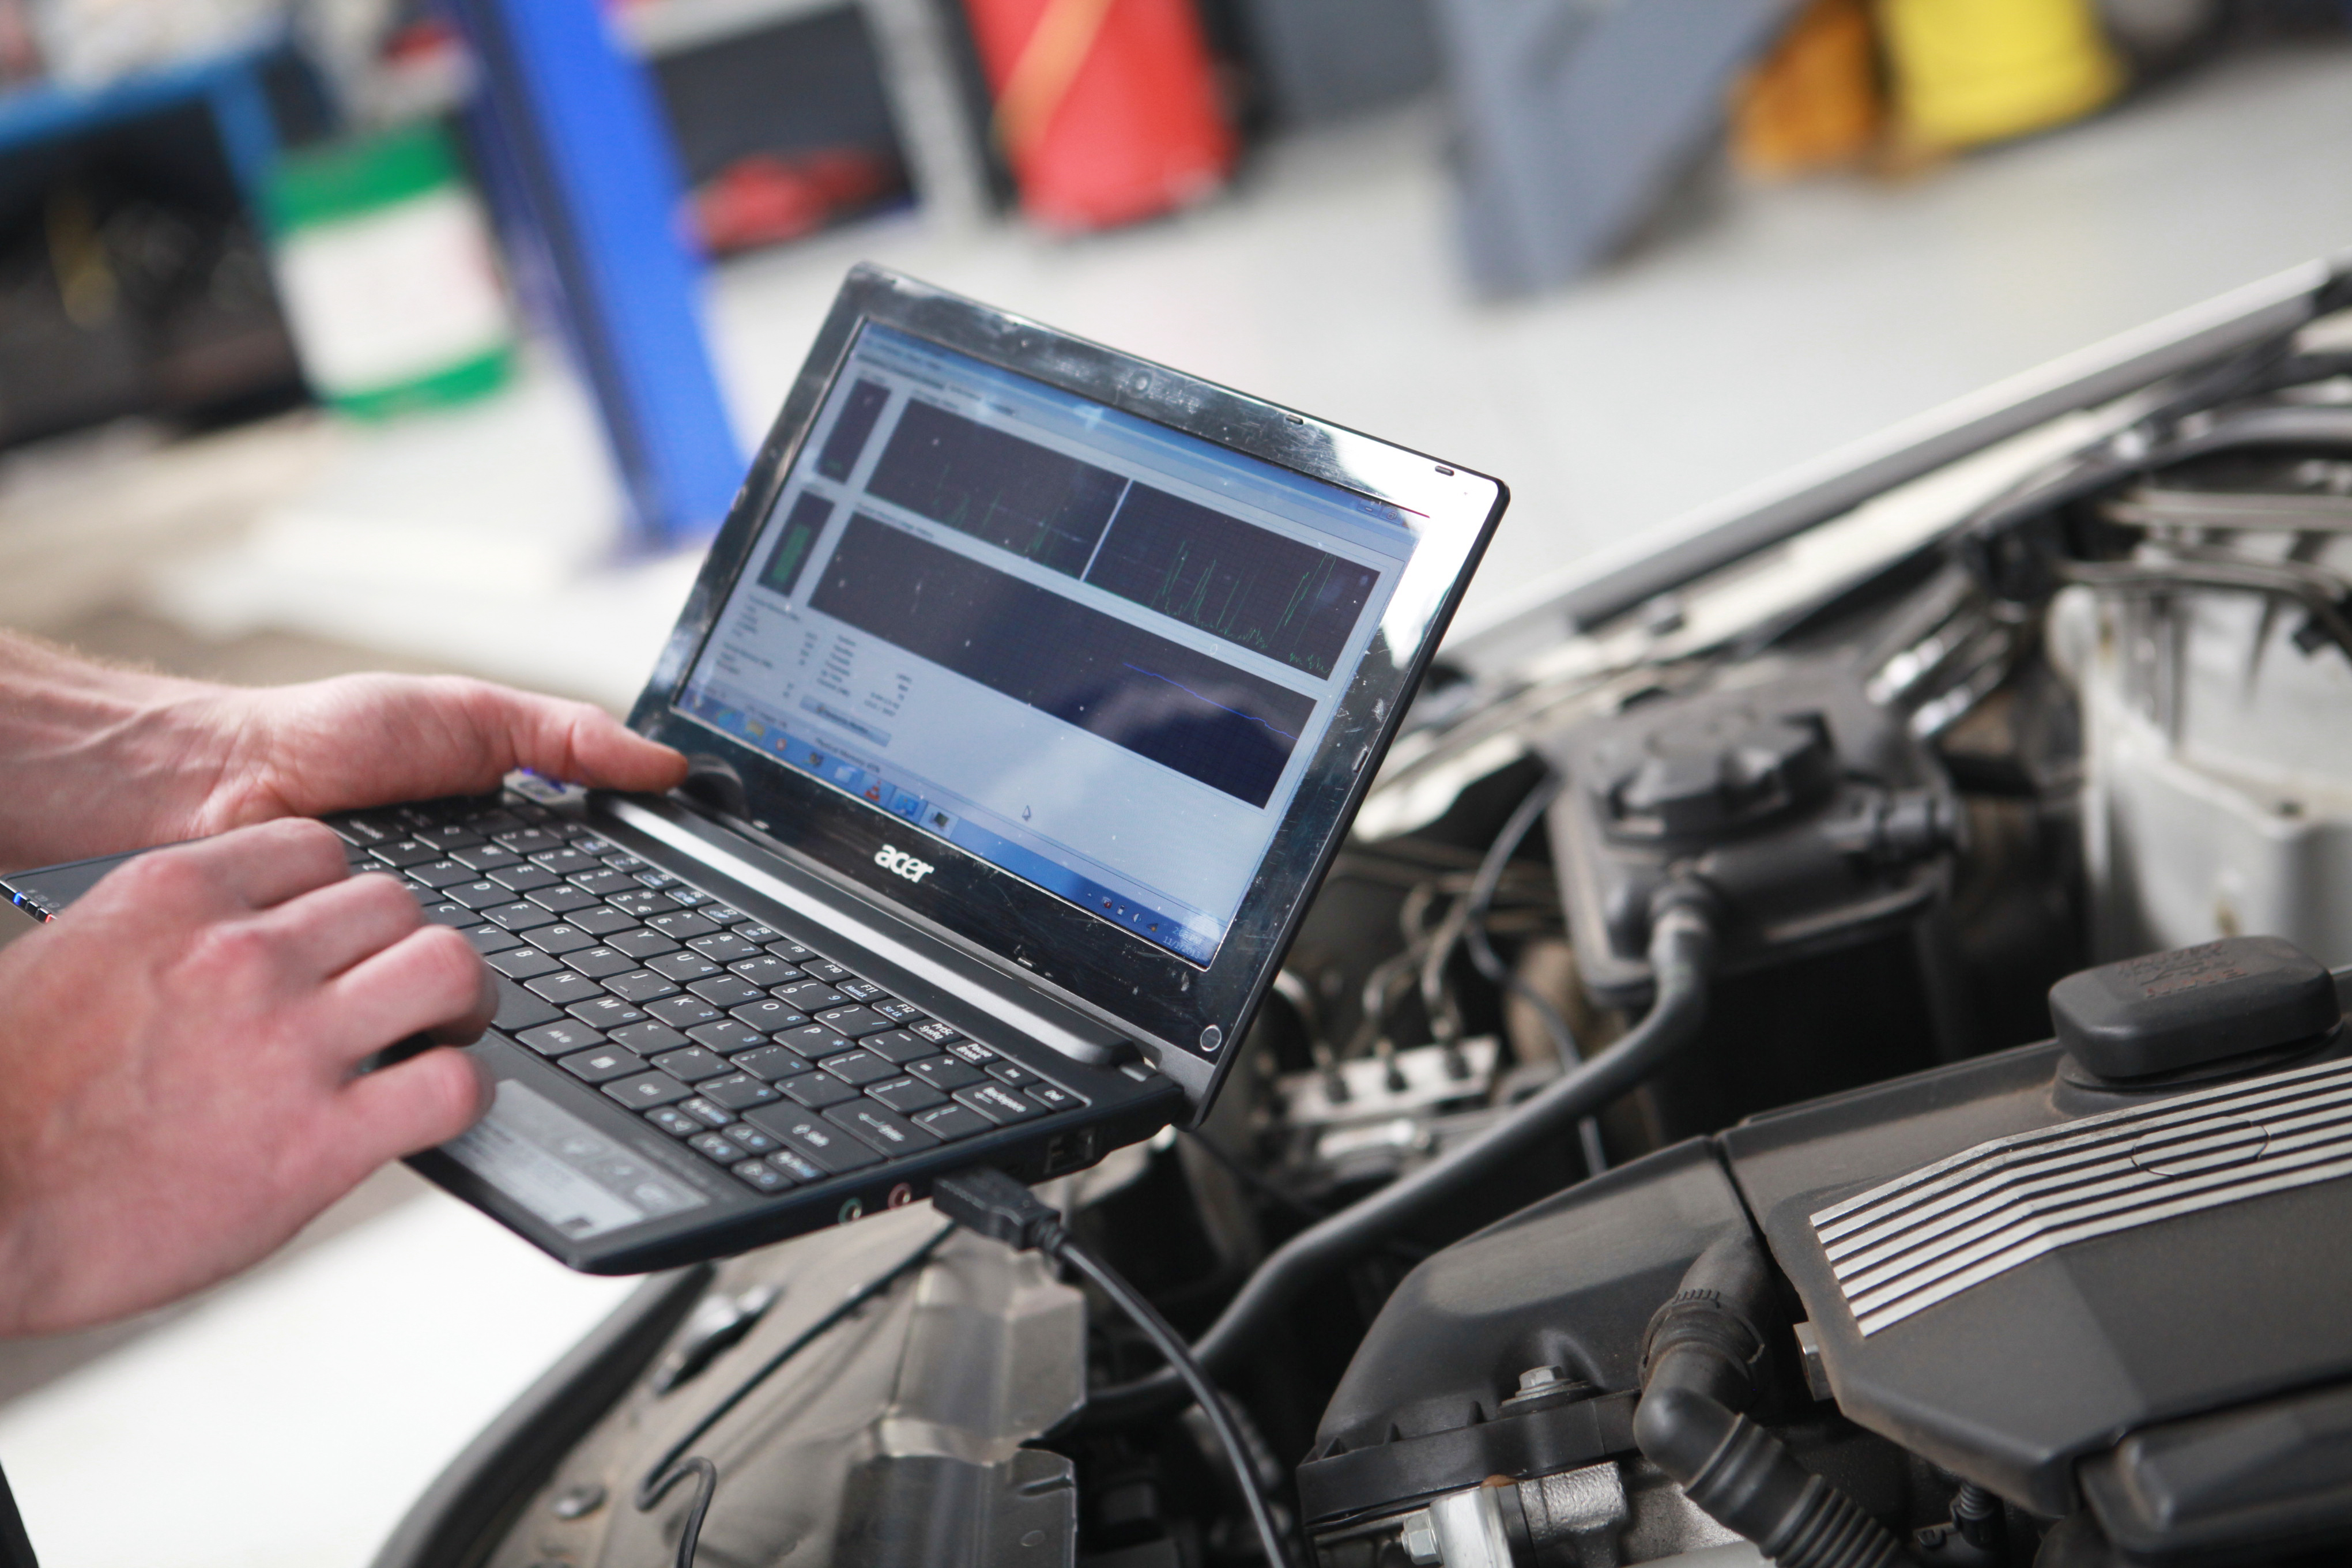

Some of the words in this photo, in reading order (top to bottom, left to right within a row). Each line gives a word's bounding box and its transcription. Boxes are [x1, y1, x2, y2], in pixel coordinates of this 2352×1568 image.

[875, 845, 934, 883] acer
[825, 964, 842, 973] F10
[845, 985, 868, 998] NumLk
[861, 984, 879, 993] F11
[597, 1000, 620, 1008] M
[896, 1004, 915, 1013] F12
[919, 1025, 944, 1040] SysRq
[932, 1023, 954, 1036] PrtSc
[956, 1045, 981, 1061] Break
[967, 1043, 993, 1058] Pause
